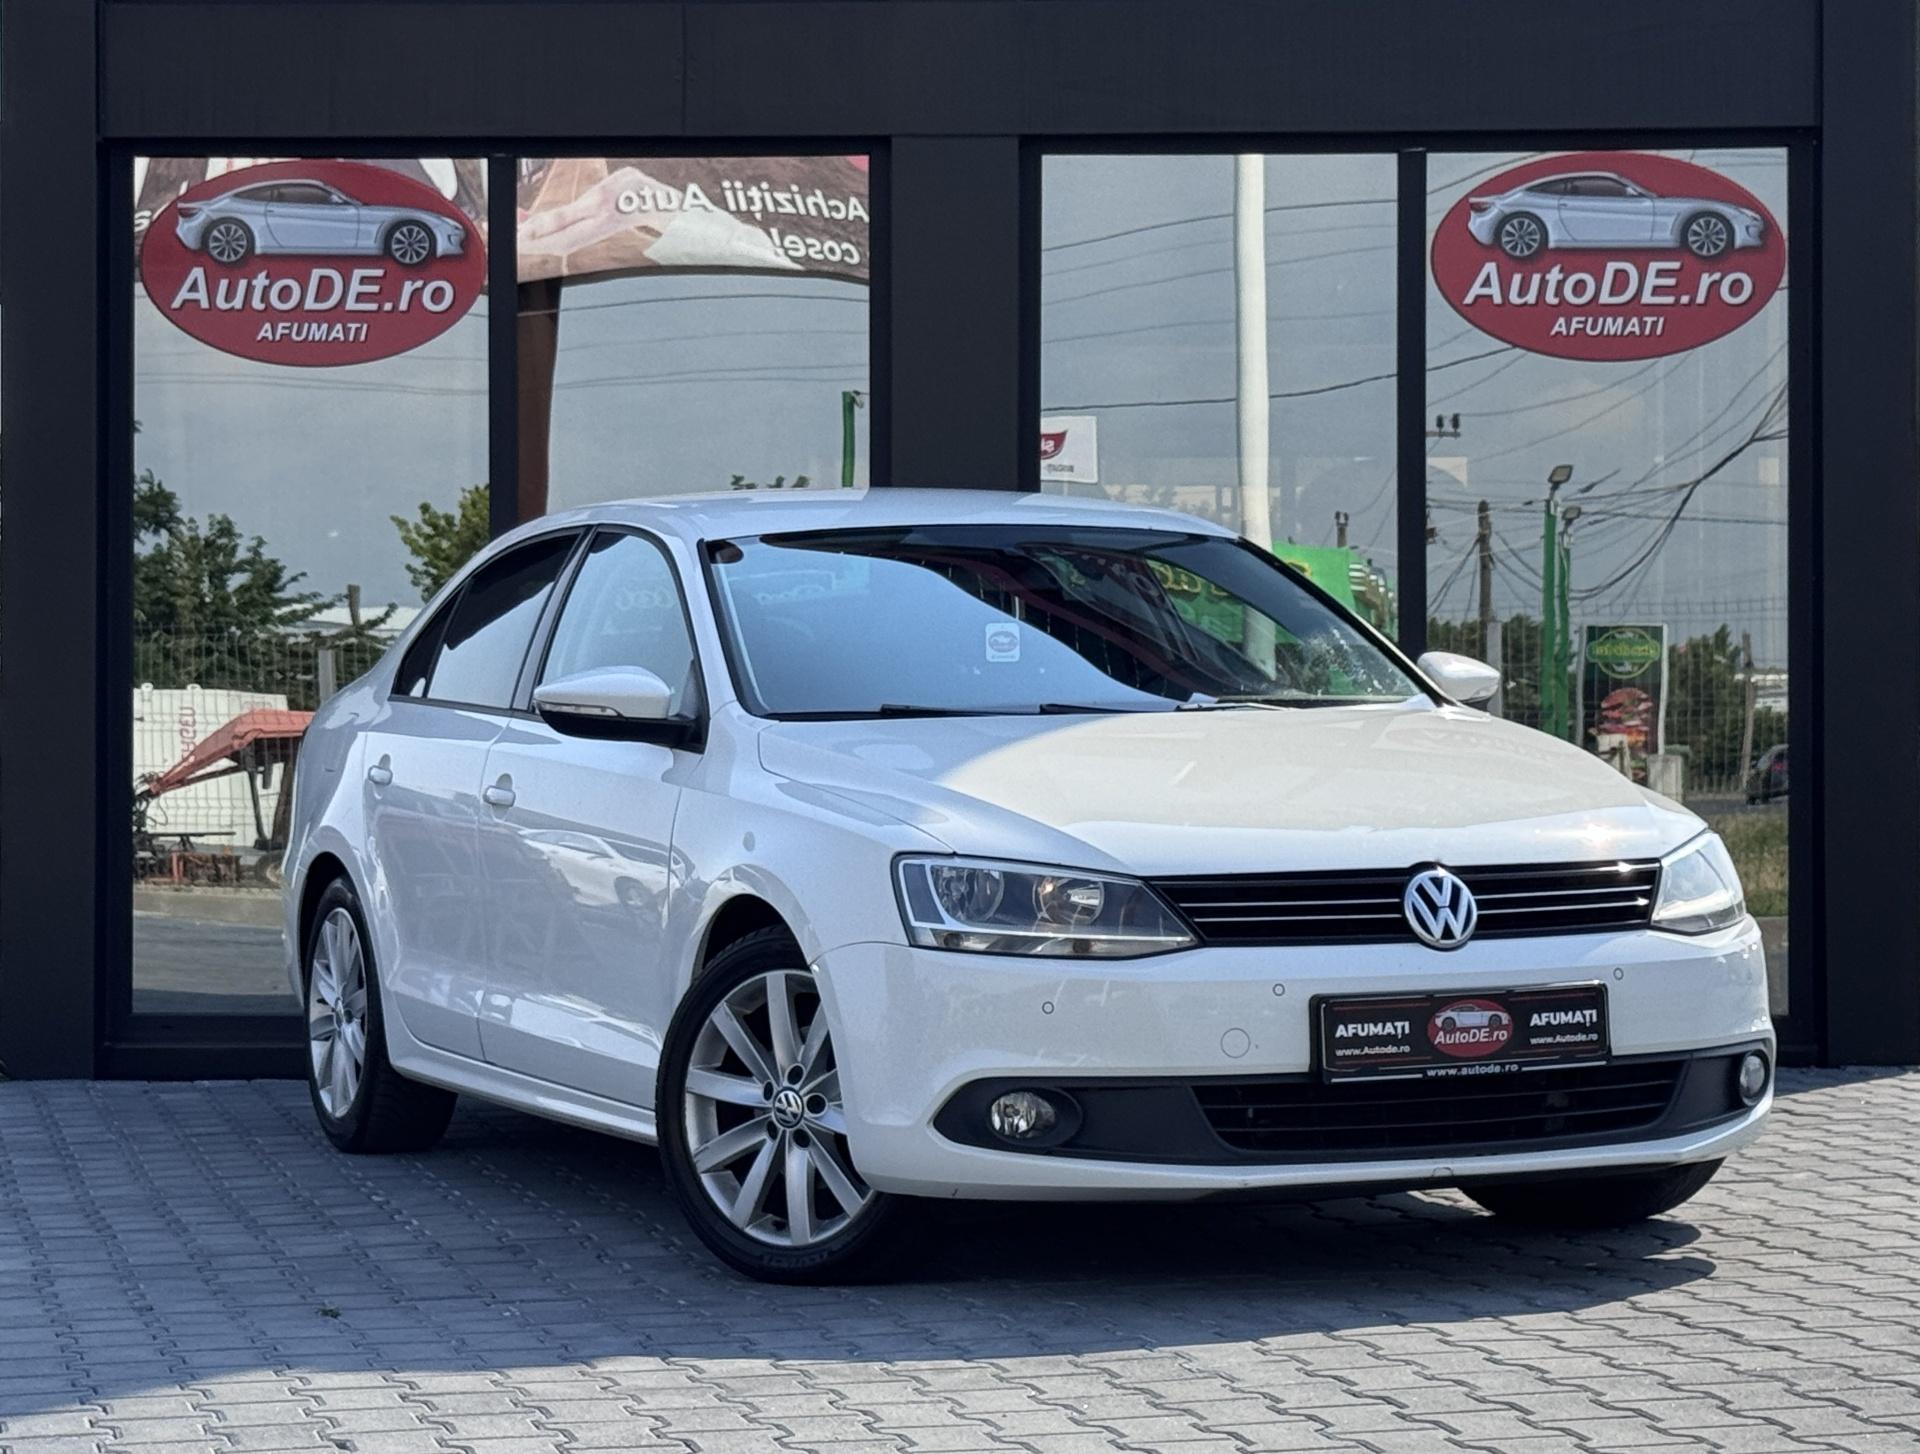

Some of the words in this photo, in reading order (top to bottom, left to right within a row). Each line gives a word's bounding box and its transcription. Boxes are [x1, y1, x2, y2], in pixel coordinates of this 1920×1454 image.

[171, 266, 456, 313] AutoDE.ro
[1462, 261, 1754, 306] AutoDE.ro
[256, 322, 370, 343] AFUMATI
[1550, 316, 1665, 337] AFUMATI
[1434, 1028, 1508, 1046] AutoDE.ro
